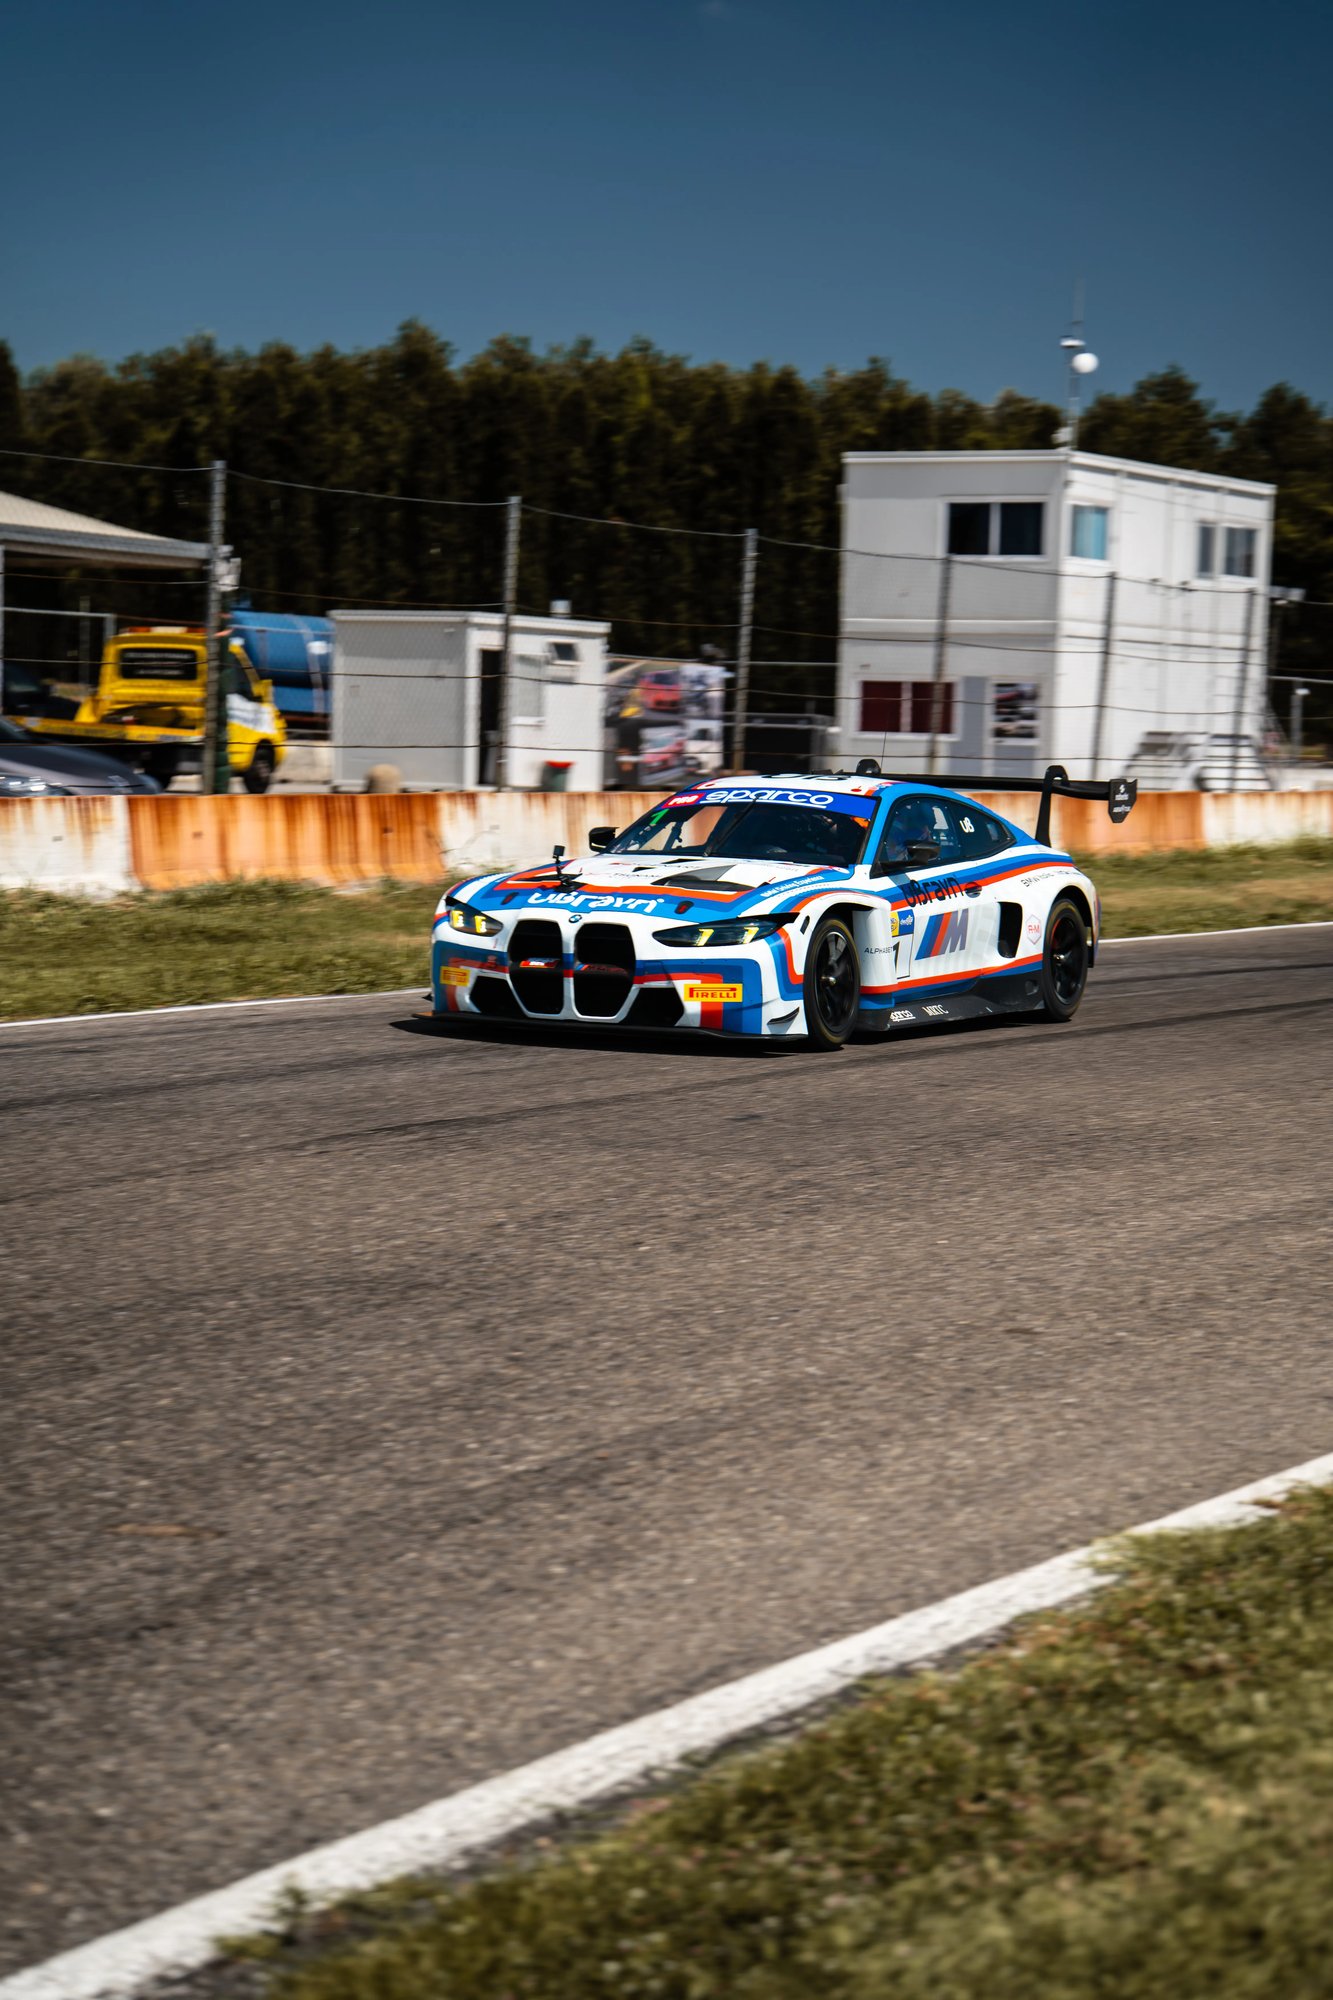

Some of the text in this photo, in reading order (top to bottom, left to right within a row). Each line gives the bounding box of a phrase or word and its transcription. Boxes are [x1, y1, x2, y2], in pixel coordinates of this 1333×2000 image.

[669, 795, 699, 806] PRO
[702, 789, 834, 808] sparco
[650, 808, 669, 826] 1
[689, 987, 737, 999] PIRELLI
